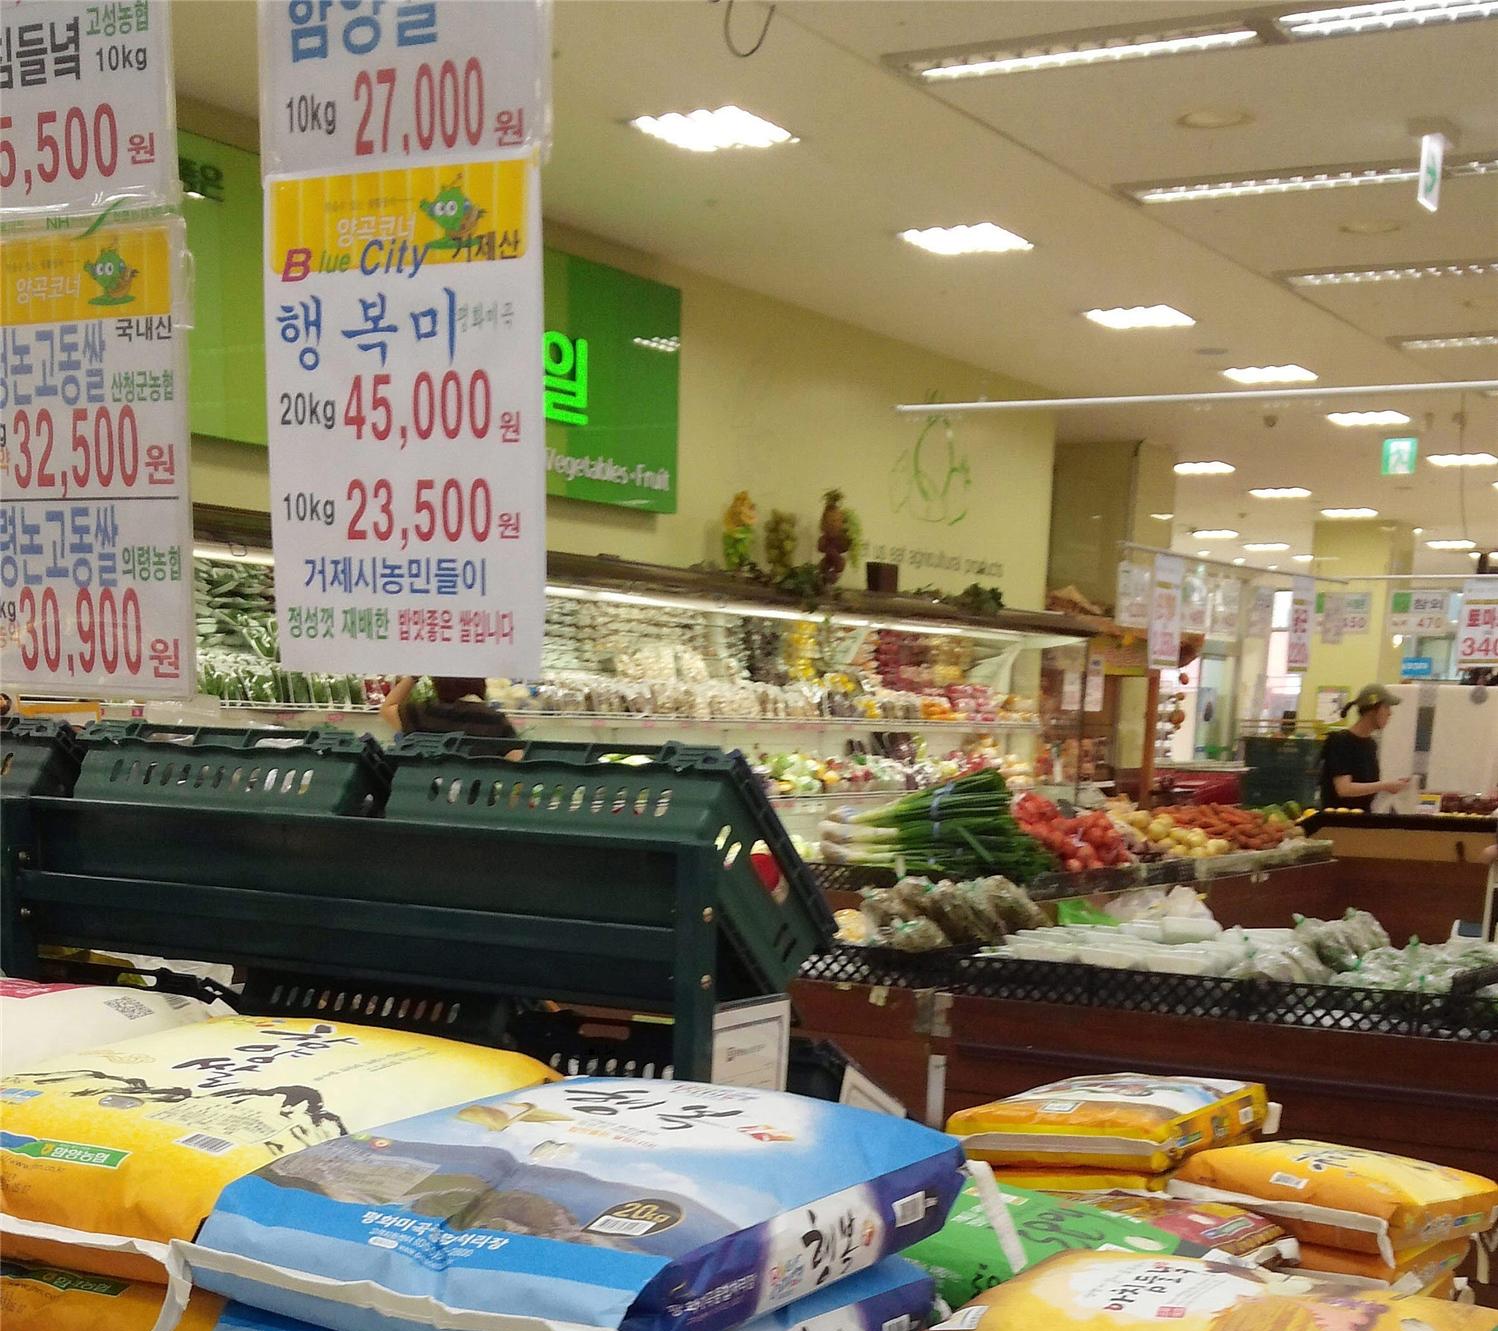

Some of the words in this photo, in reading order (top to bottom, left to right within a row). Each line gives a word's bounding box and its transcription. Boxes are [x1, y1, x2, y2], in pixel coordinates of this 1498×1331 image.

[96, 44, 147, 72] 10kg
[286, 93, 336, 135] 10kg
[353, 56, 484, 156] 27,000
[494, 107, 524, 147] 원
[128, 132, 155, 165] 원
[359, 238, 432, 280] City
[280, 392, 336, 429] 20kg
[343, 368, 492, 449] 45,000
[499, 410, 521, 443] 원
[13, 404, 139, 498] 32,500
[144, 443, 175, 485] 원
[283, 492, 336, 526] 10kg
[346, 477, 493, 550] 23,500
[498, 511, 521, 540] 원
[304, 556, 487, 597] 거제시농민들이
[19, 586, 142, 677] 30,900
[149, 638, 180, 679] 원
[287, 606, 335, 640] 정성껏
[341, 606, 389, 641] 재배한
